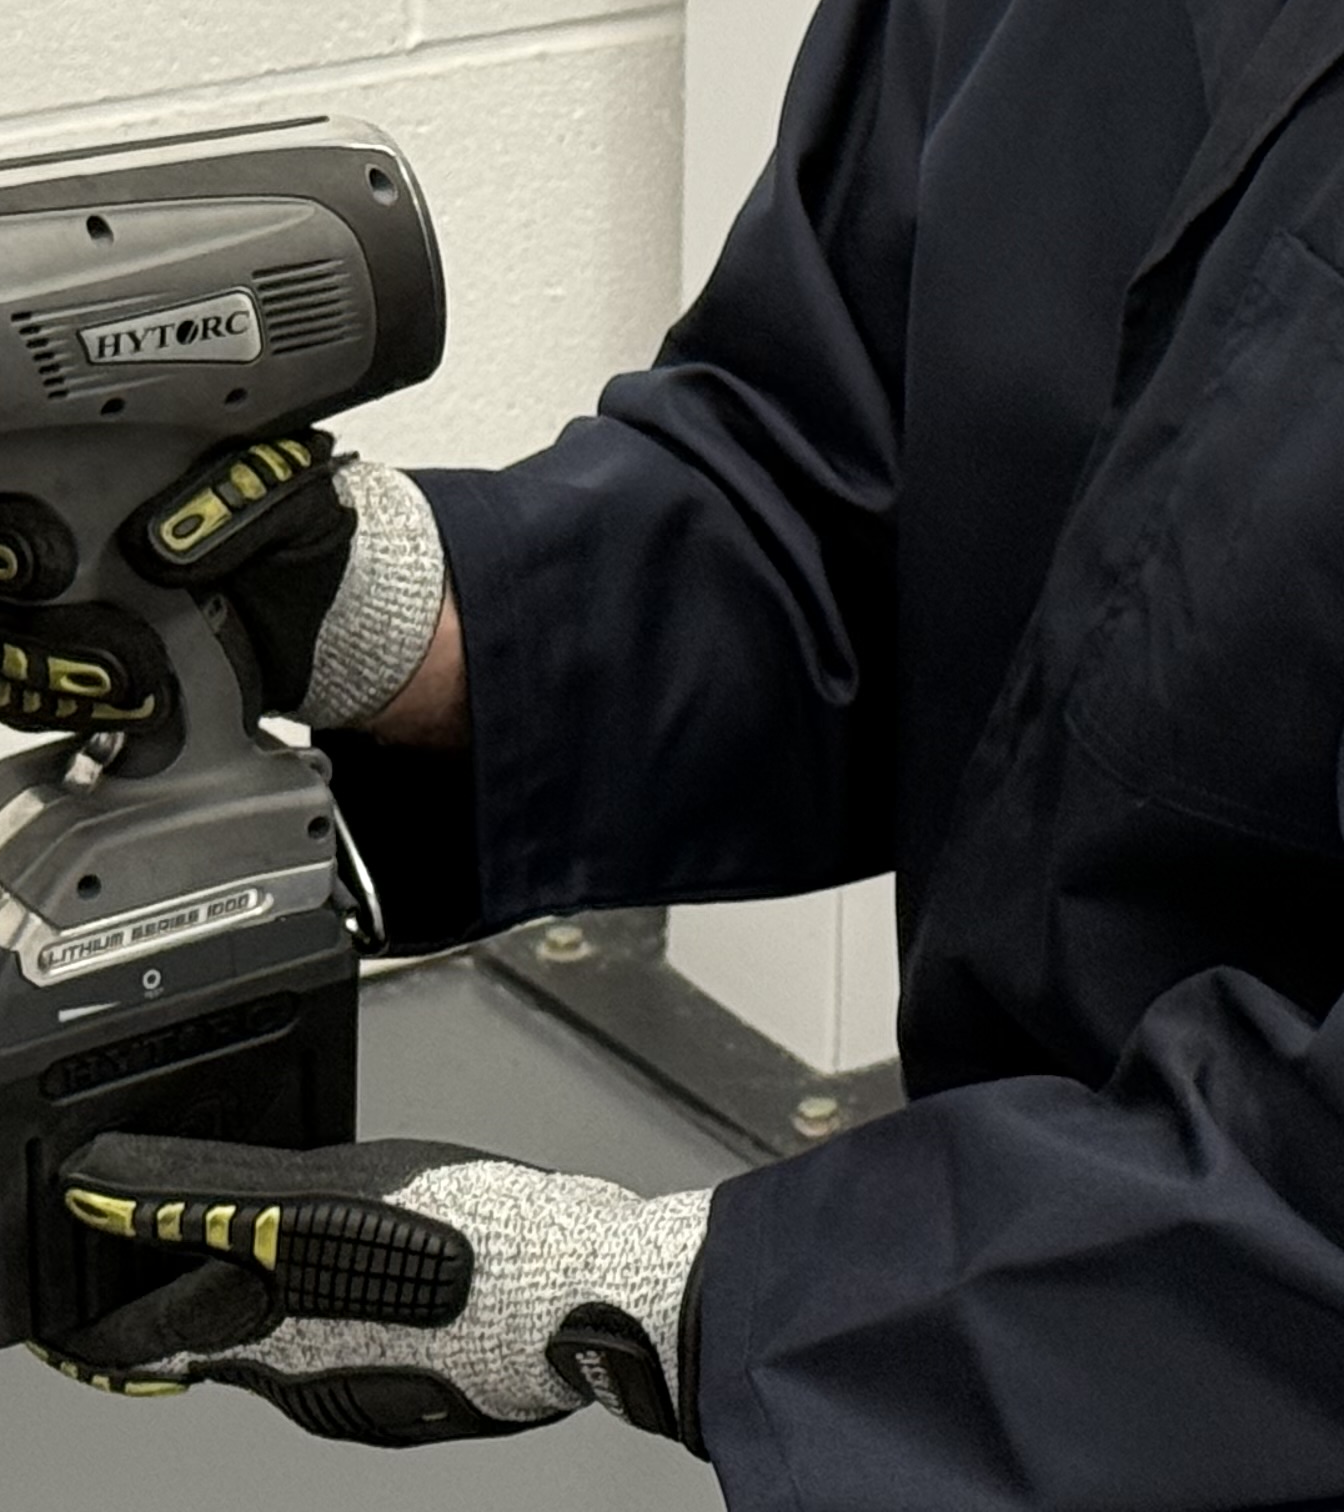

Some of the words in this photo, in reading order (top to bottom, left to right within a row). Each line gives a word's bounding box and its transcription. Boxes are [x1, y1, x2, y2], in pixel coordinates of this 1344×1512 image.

[95, 310, 251, 359] HYTORC
[49, 931, 124, 967] LITHIUM
[131, 909, 200, 940] SERIES
[207, 893, 250, 919] 1000
